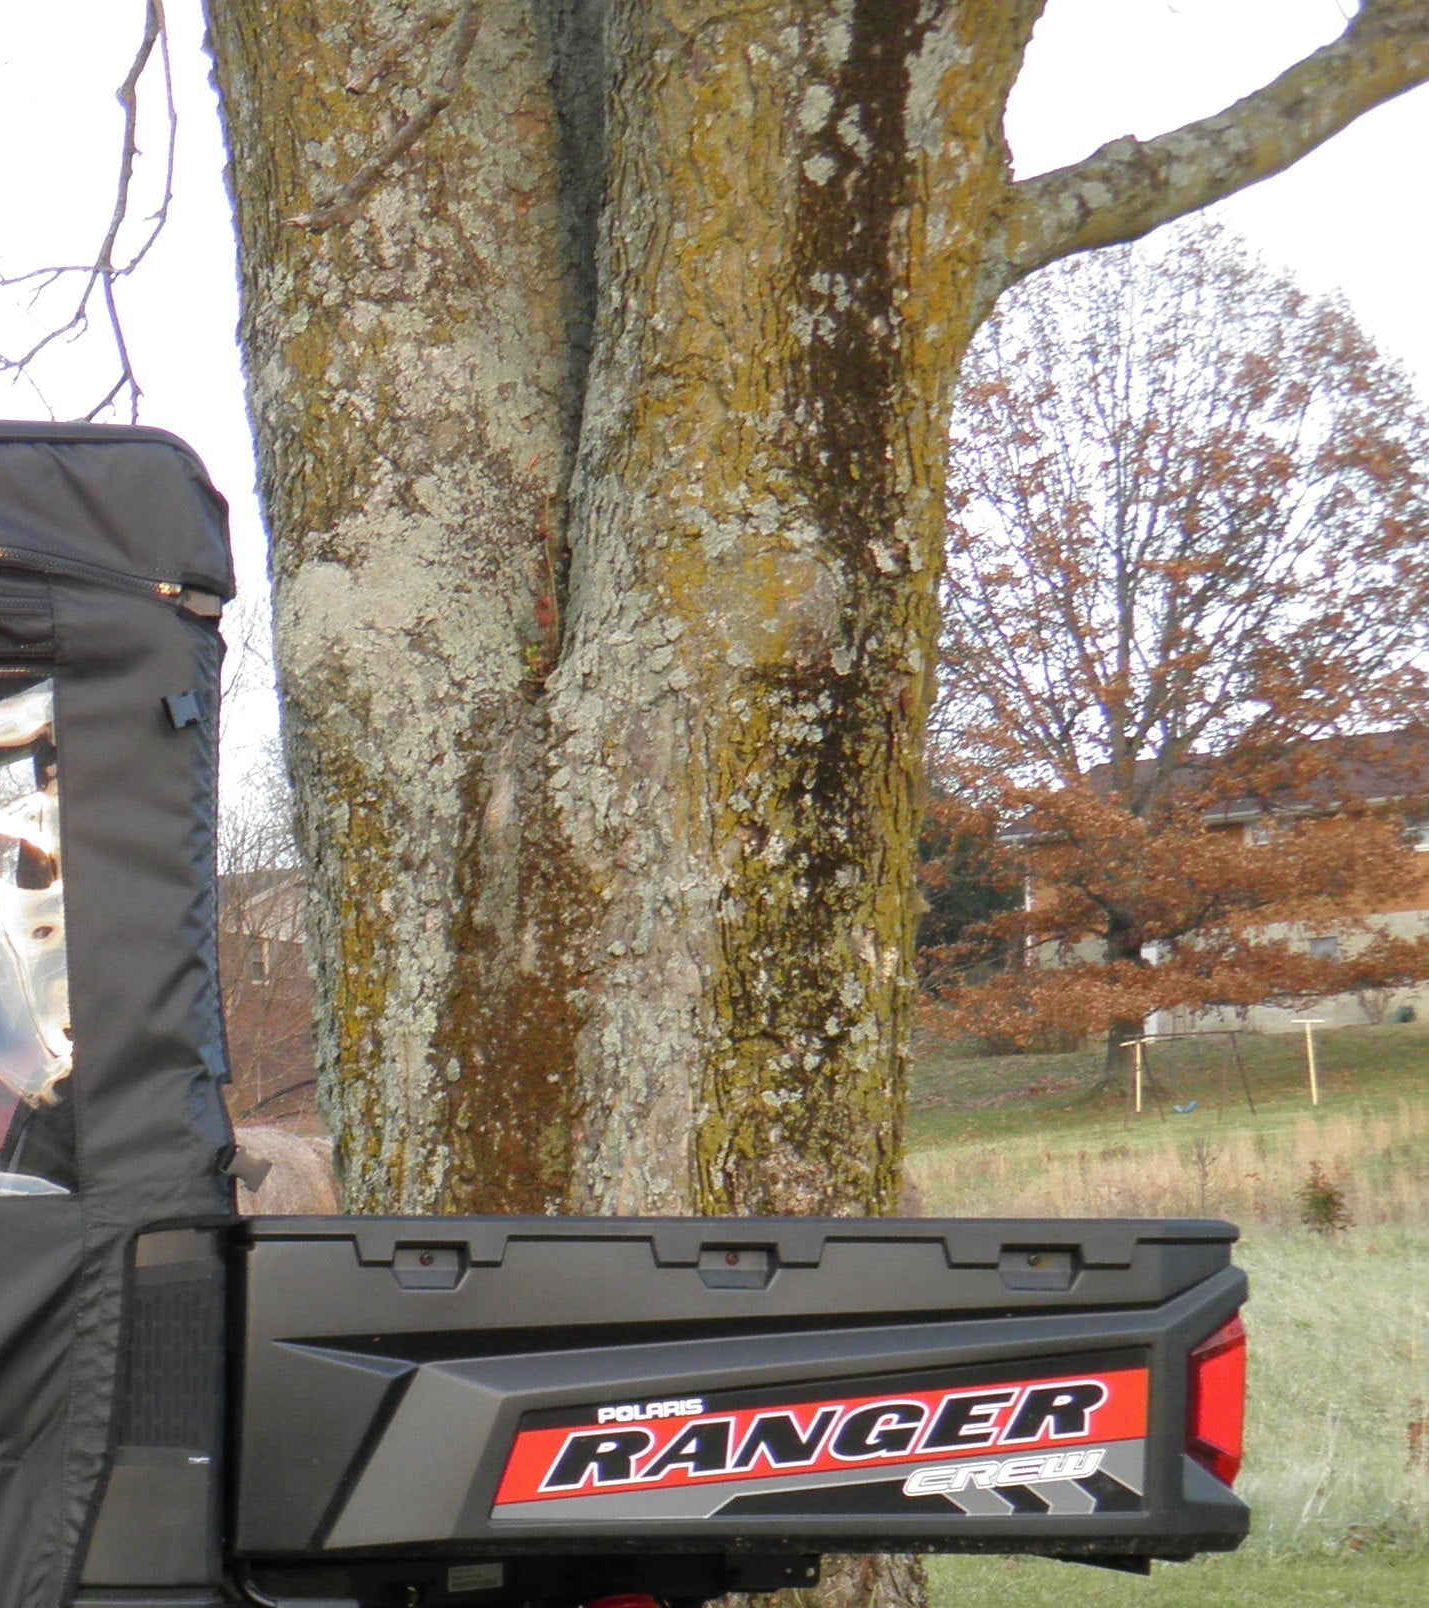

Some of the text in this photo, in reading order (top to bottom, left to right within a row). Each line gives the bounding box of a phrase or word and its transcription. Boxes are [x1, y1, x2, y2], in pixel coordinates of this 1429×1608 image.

[597, 1398, 704, 1425] POLARIS
[538, 1379, 1108, 1493] RANGER
[902, 1449, 1107, 1497] CREW
